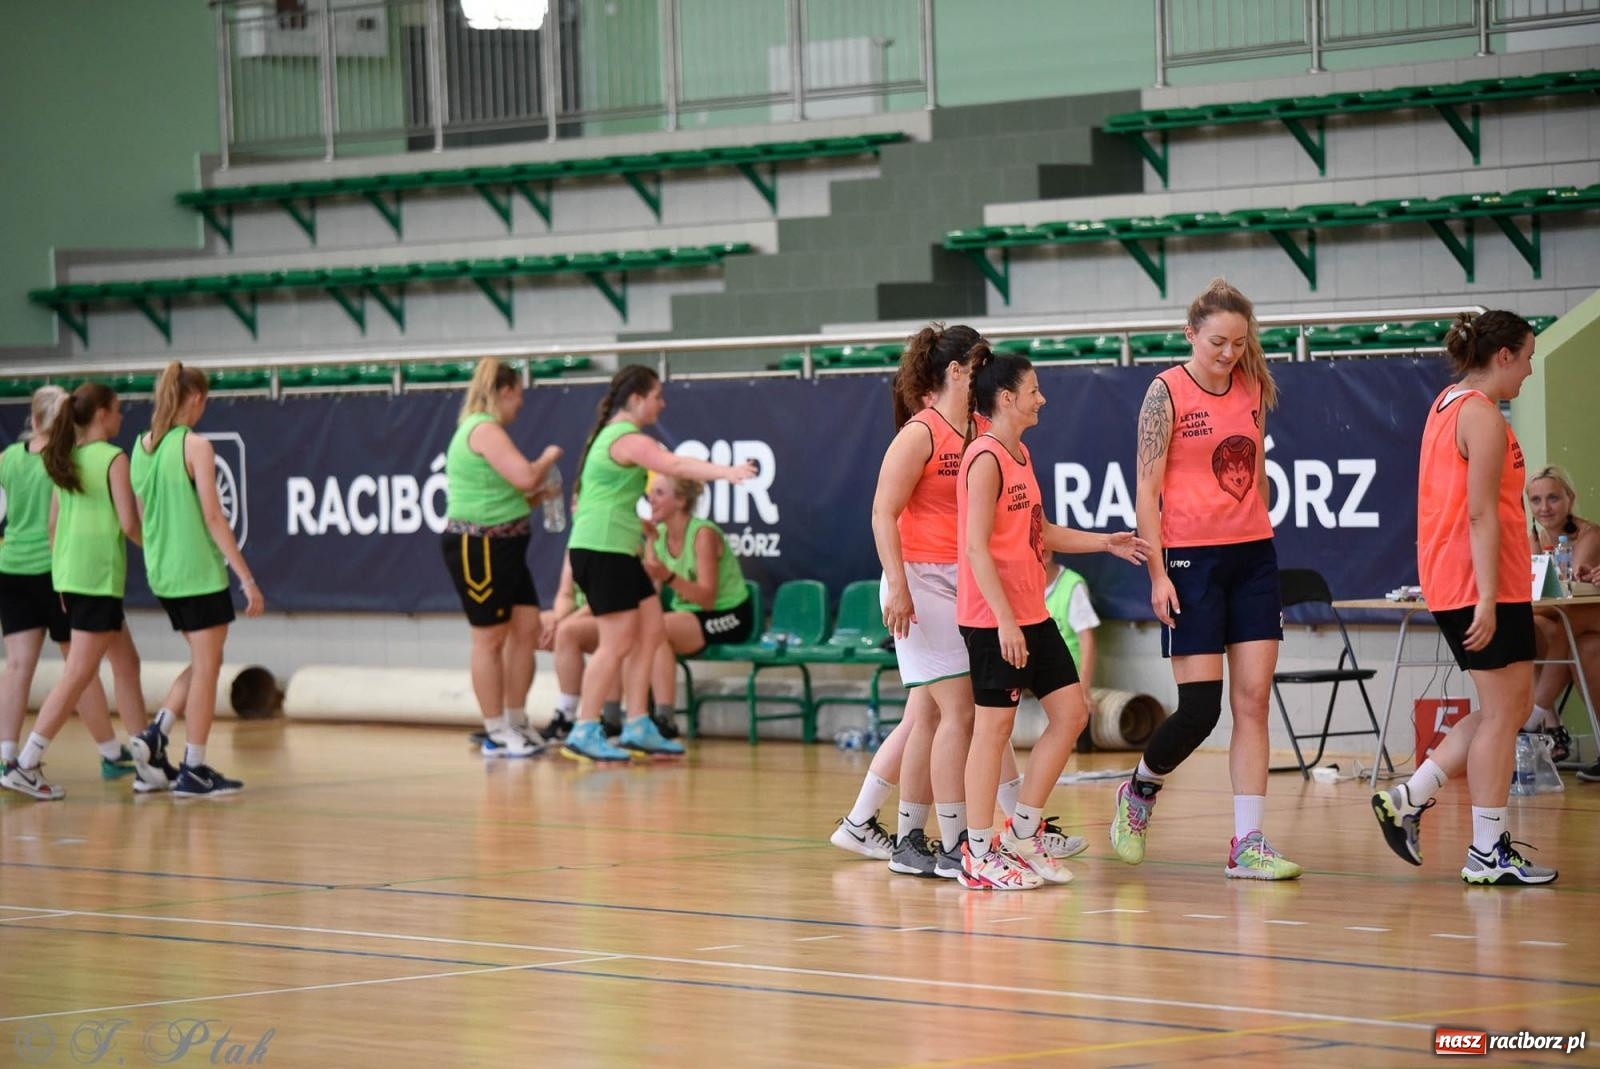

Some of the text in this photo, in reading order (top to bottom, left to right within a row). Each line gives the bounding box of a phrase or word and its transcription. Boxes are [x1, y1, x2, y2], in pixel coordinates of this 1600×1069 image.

[1180, 411, 1209, 422] LETNIA
[1186, 420, 1206, 428] LIGA
[1182, 428, 1213, 437] KOBIET
[287, 452, 449, 536] RACIBÓ
[1008, 483, 1027, 494] LETNIA
[1012, 494, 1027, 502] LIGA
[1008, 501, 1030, 512] KOBIET
